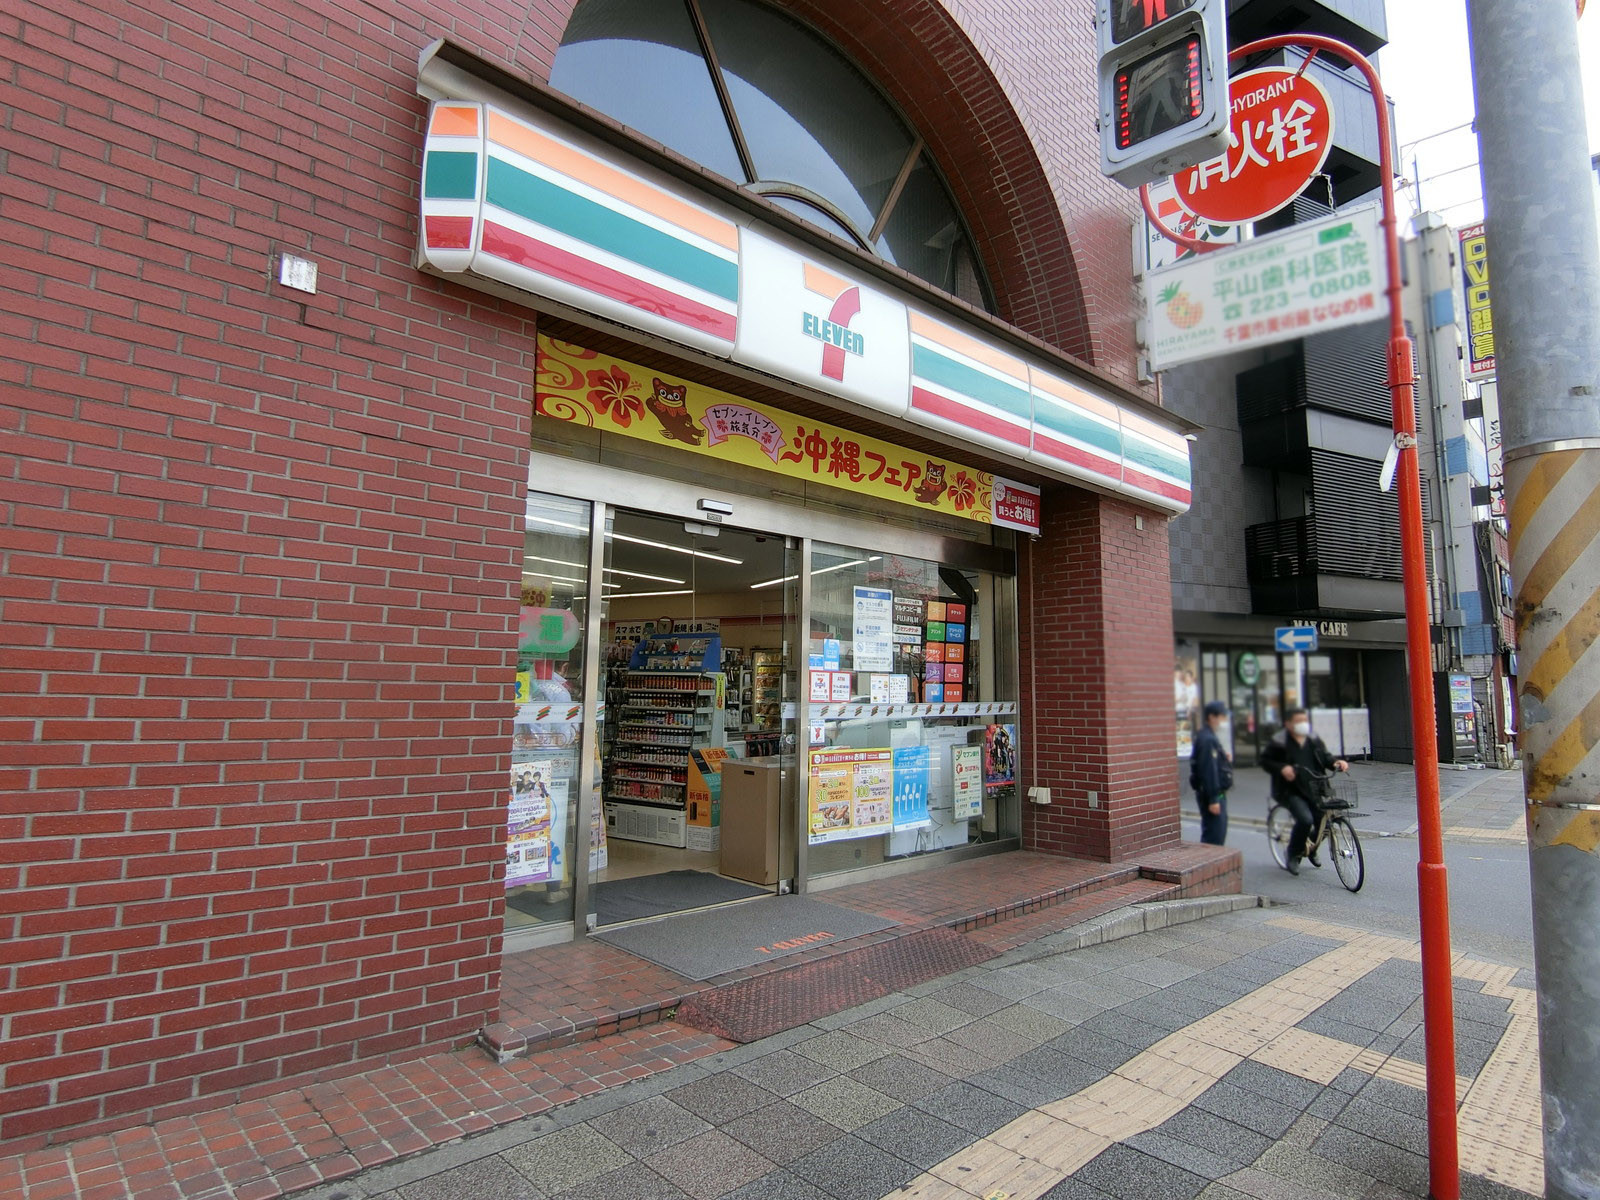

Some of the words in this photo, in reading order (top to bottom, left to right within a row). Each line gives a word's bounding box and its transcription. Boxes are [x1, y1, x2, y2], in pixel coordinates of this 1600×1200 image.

[1213, 241, 1370, 301] 平山歯科医院
[730, 420, 761, 439] 旅気分
[780, 425, 922, 492] 沖縄フェア
[1320, 621, 1348, 637] CAFE
